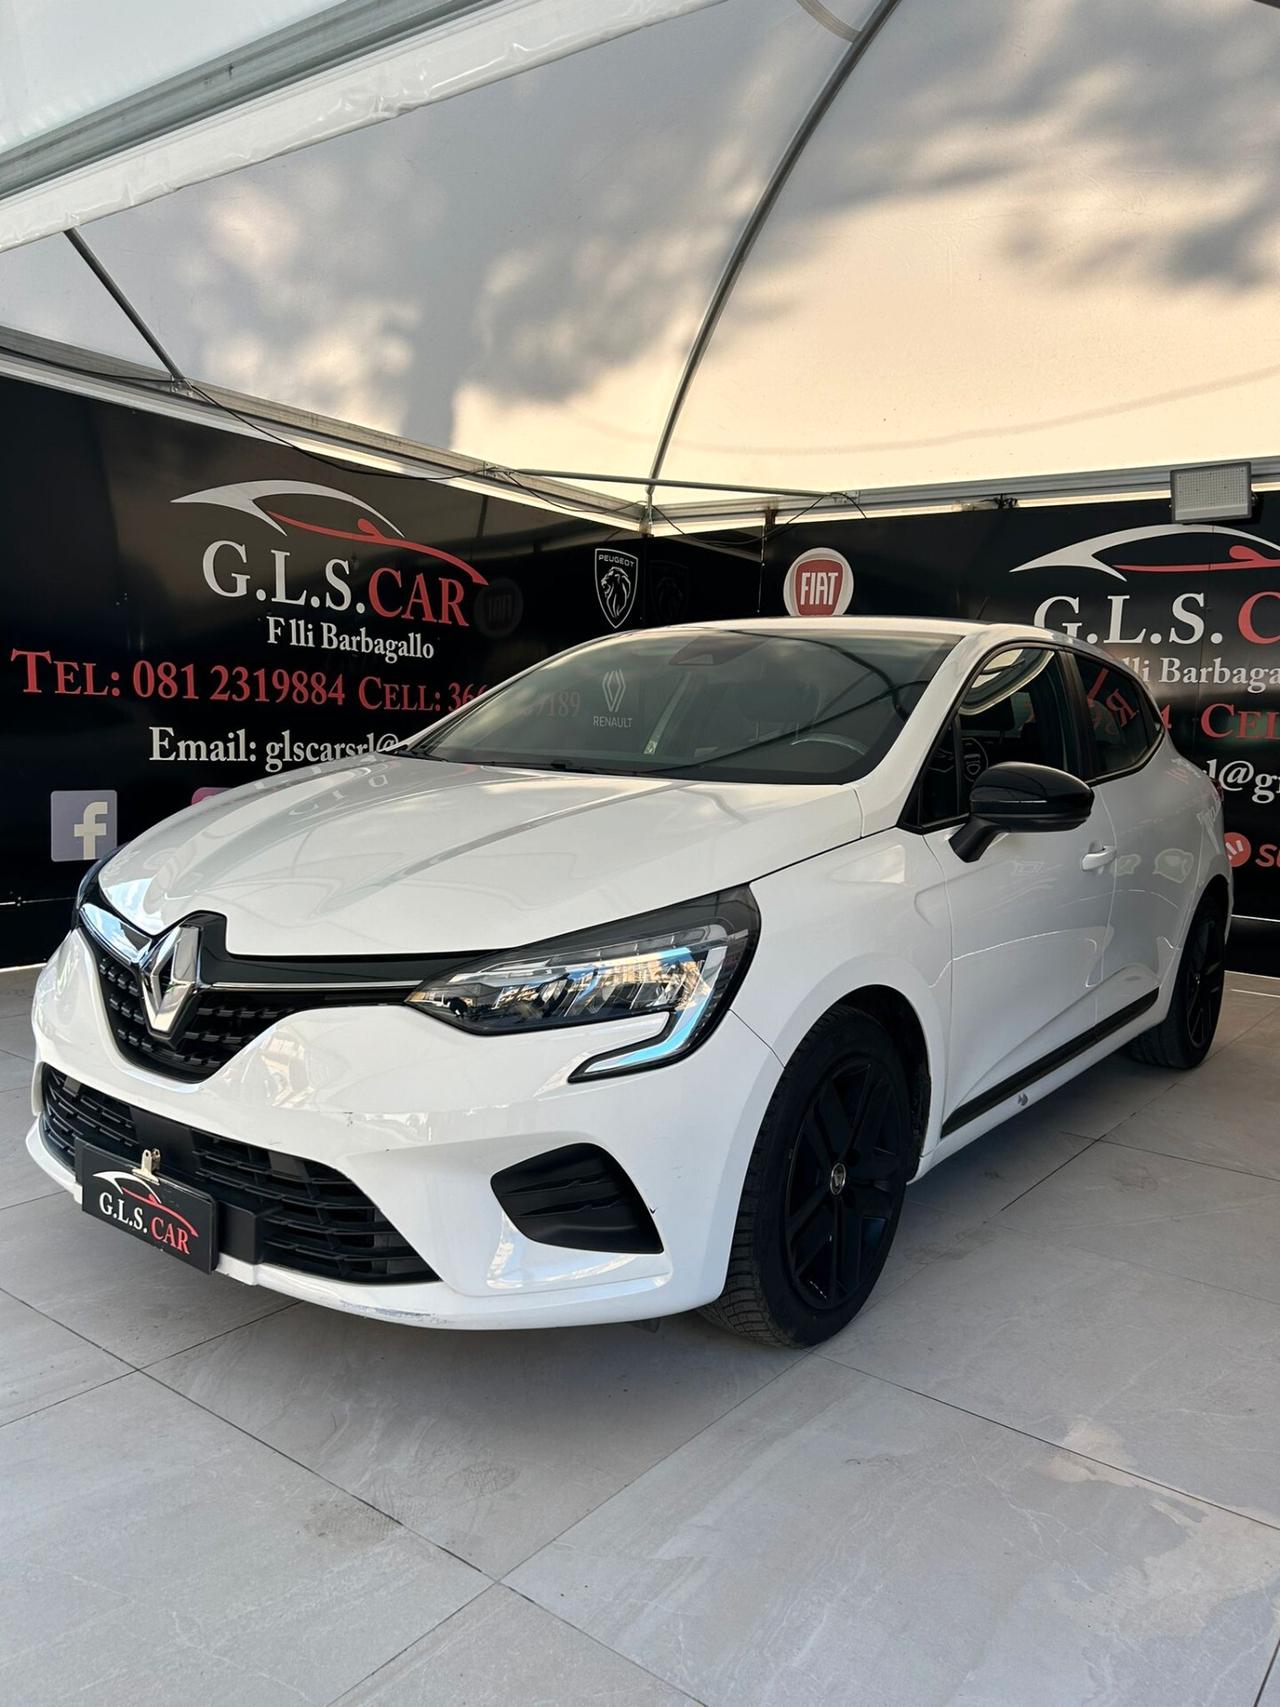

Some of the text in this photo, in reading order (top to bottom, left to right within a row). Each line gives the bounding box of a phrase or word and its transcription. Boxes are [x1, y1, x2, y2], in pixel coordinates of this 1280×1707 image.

[598, 554, 635, 568] PEUGEOT
[800, 571, 838, 606] FIAT
[321, 622, 434, 664] Barbagallo
[132, 660, 199, 699] 081
[209, 665, 346, 705] 2319884
[593, 715, 632, 729] RENAULT
[149, 726, 257, 763] Email:
